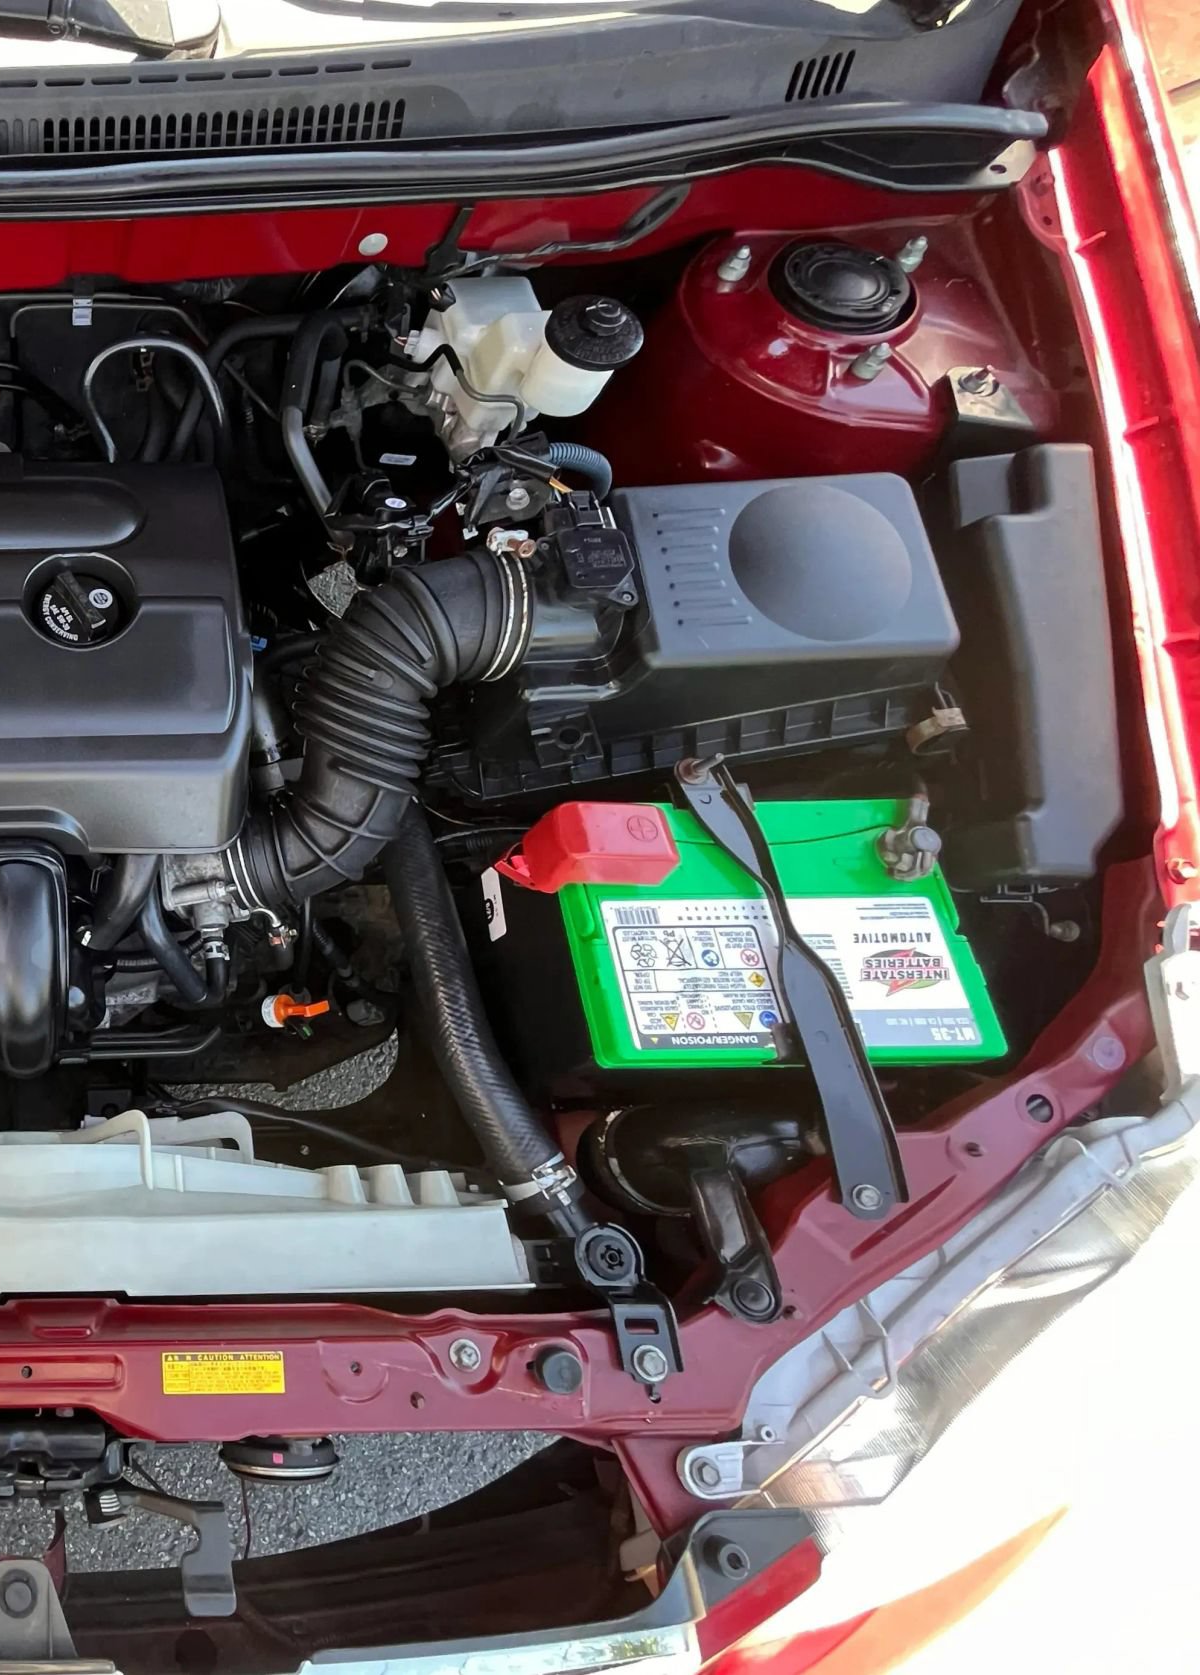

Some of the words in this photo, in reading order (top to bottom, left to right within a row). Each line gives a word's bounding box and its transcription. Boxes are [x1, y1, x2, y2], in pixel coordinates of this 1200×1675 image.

[44, 616, 78, 641] CONSERVING
[854, 932, 932, 944] AUTOMOTIVE
[864, 958, 941, 968] BATTERIES
[863, 969, 948, 980] INTERSTATE
[671, 1034, 758, 1045] DANGER/POISON
